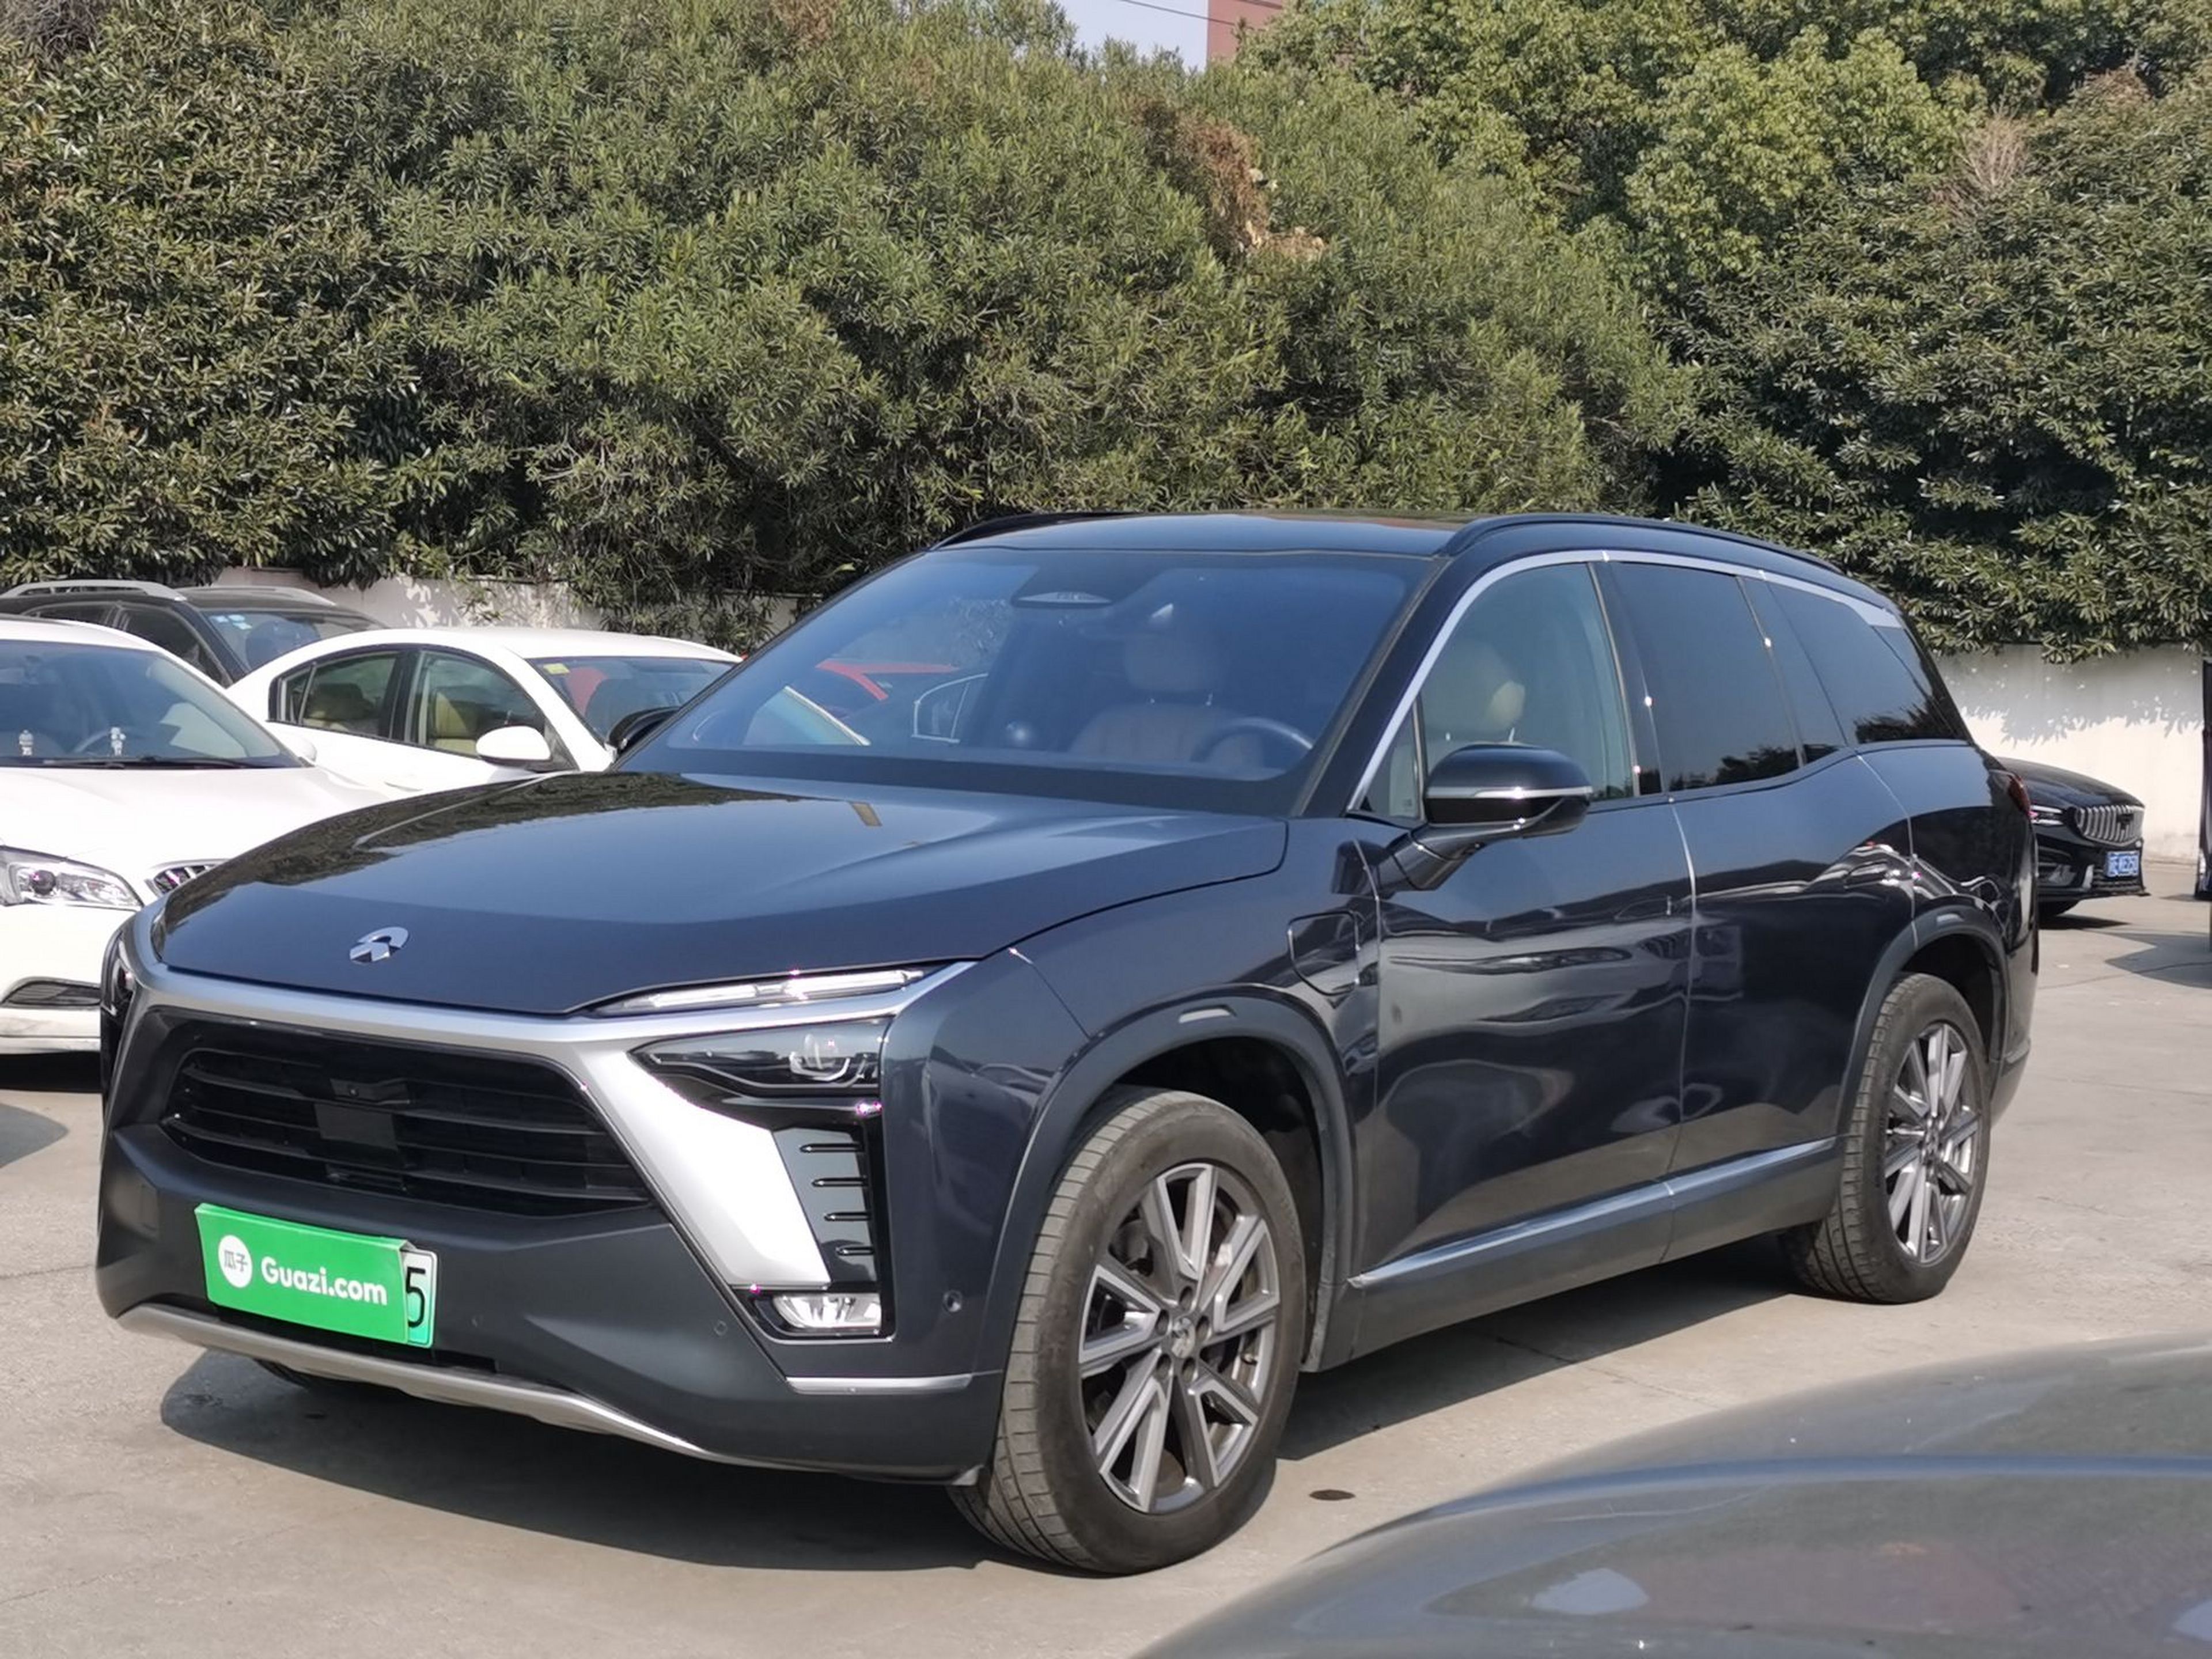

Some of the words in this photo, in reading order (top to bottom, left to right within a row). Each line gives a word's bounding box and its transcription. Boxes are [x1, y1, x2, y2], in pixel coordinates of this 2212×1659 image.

[224, 1249, 248, 1272] 瓜子
[261, 1256, 388, 1306] Guazi.com
[406, 1266, 426, 1328] 5
